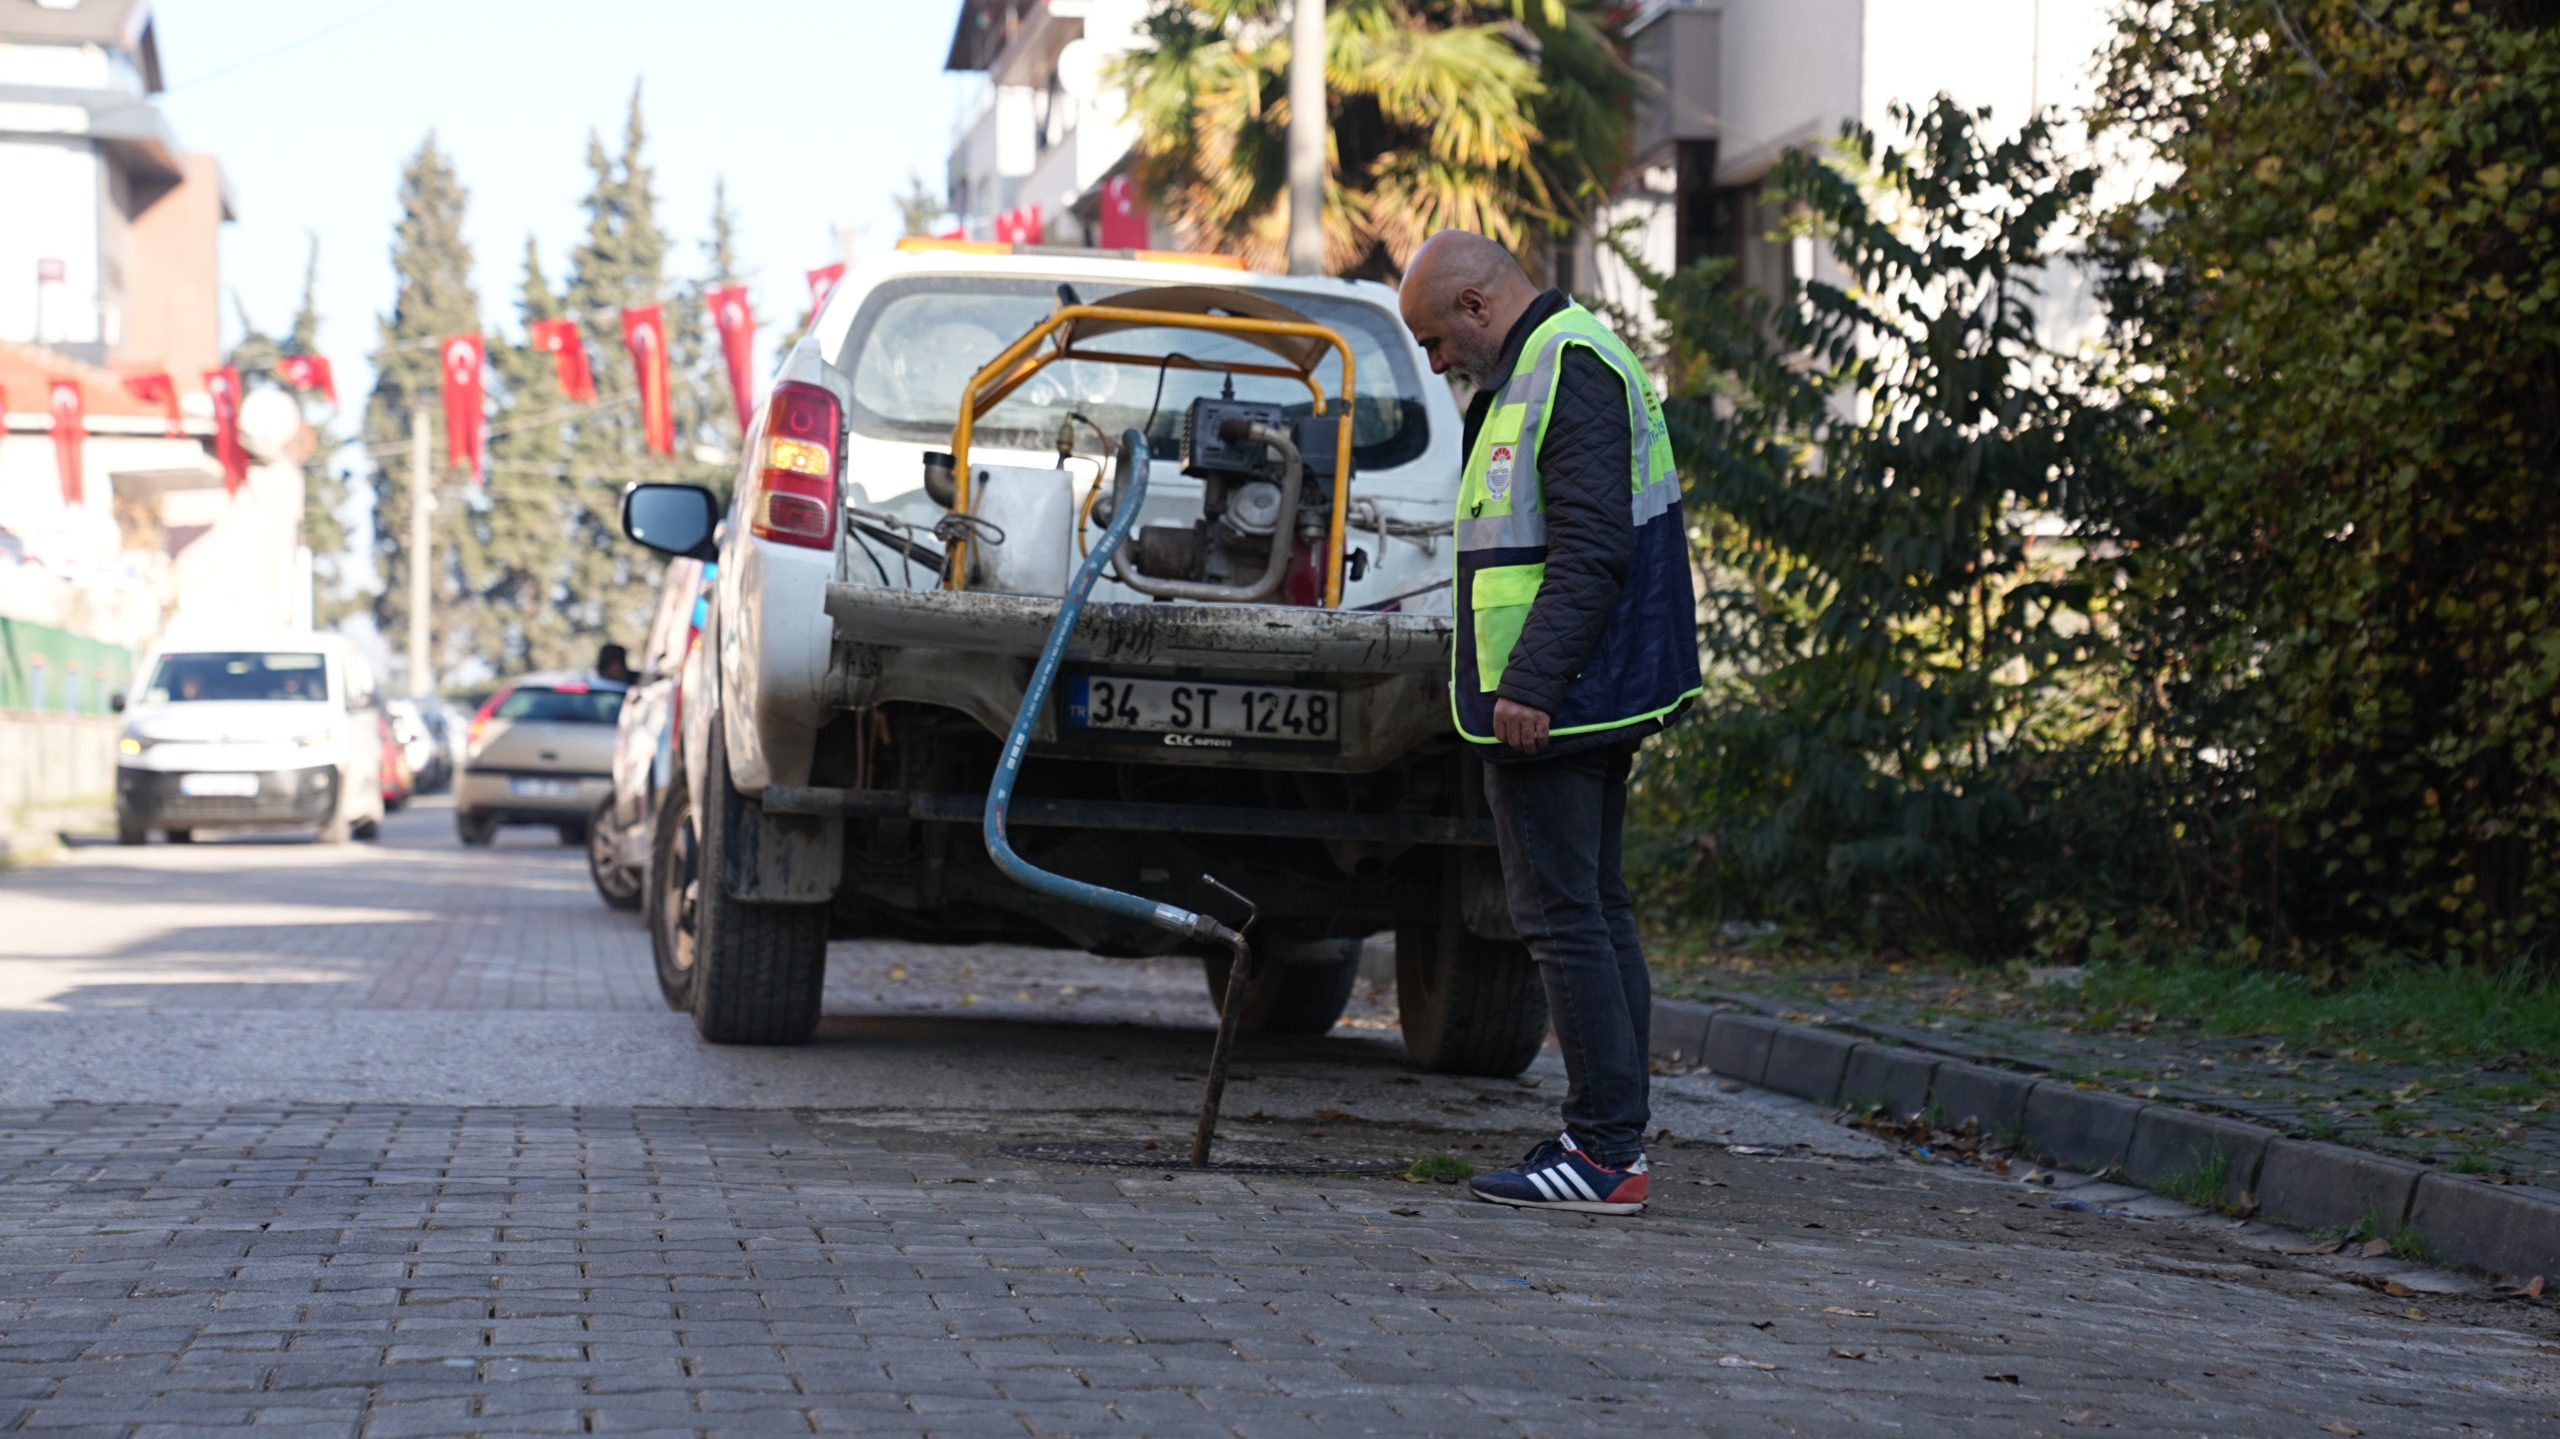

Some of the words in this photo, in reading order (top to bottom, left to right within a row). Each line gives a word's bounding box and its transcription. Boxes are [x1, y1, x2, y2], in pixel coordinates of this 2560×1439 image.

[1069, 704, 1087, 718] TR
[1092, 681, 1140, 725] 34
[1170, 686, 1218, 730] ST
[1241, 690, 1330, 737] 1248
